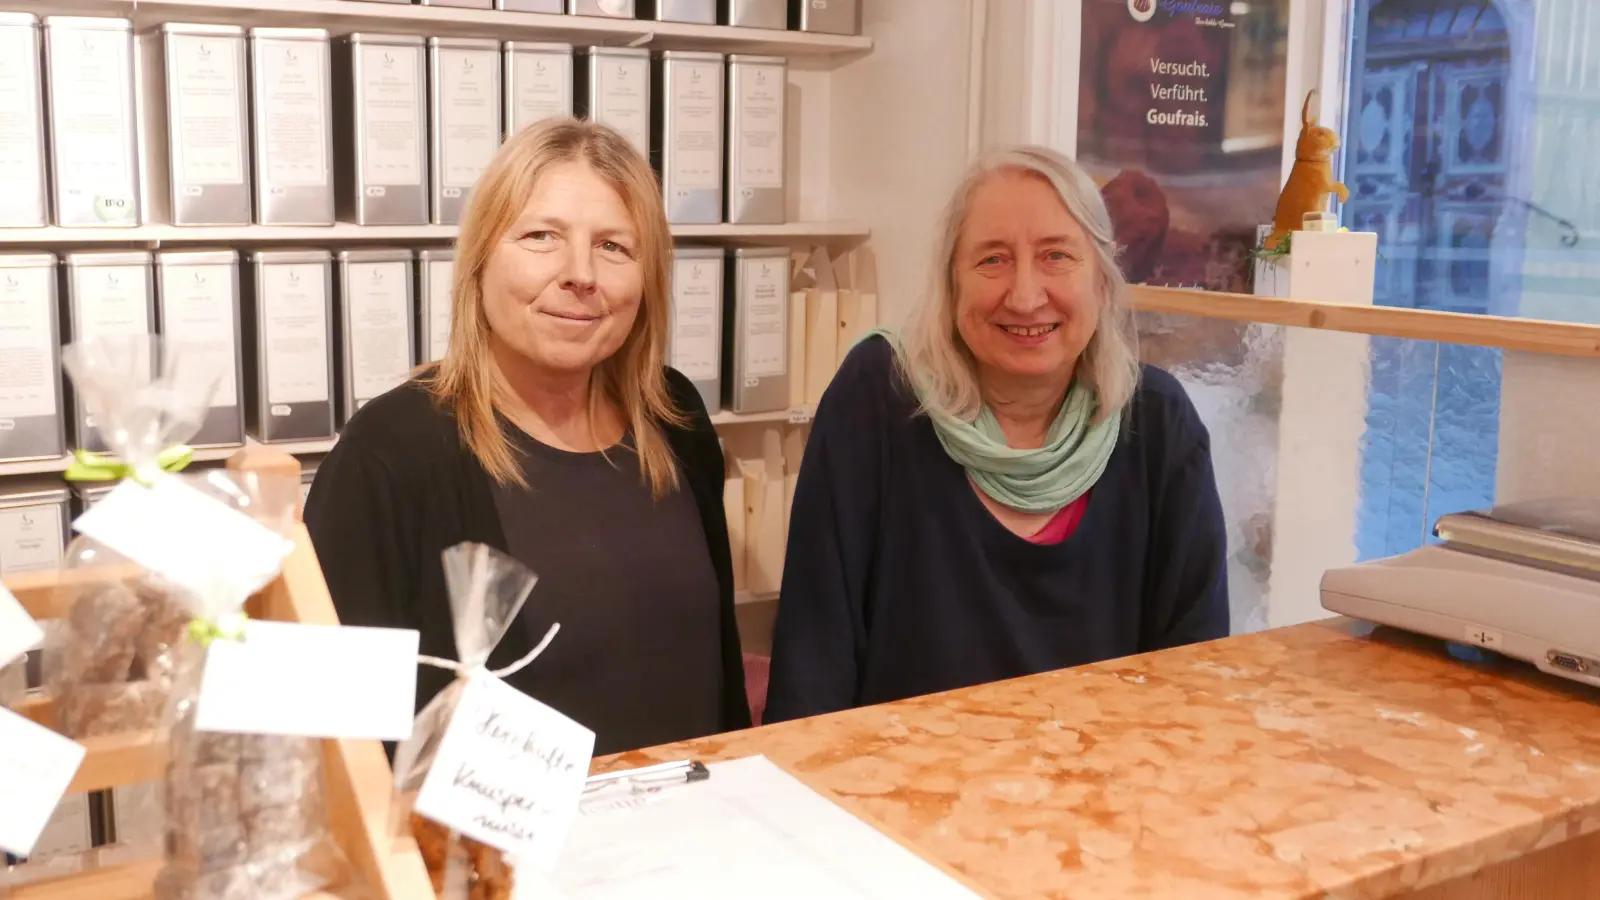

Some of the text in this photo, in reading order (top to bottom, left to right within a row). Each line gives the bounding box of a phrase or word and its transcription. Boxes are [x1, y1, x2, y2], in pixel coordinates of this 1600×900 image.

[1150, 58, 1210, 77] Versucht.
[1150, 83, 1208, 102] Verführt.
[1147, 108, 1209, 127] Goufrais.
